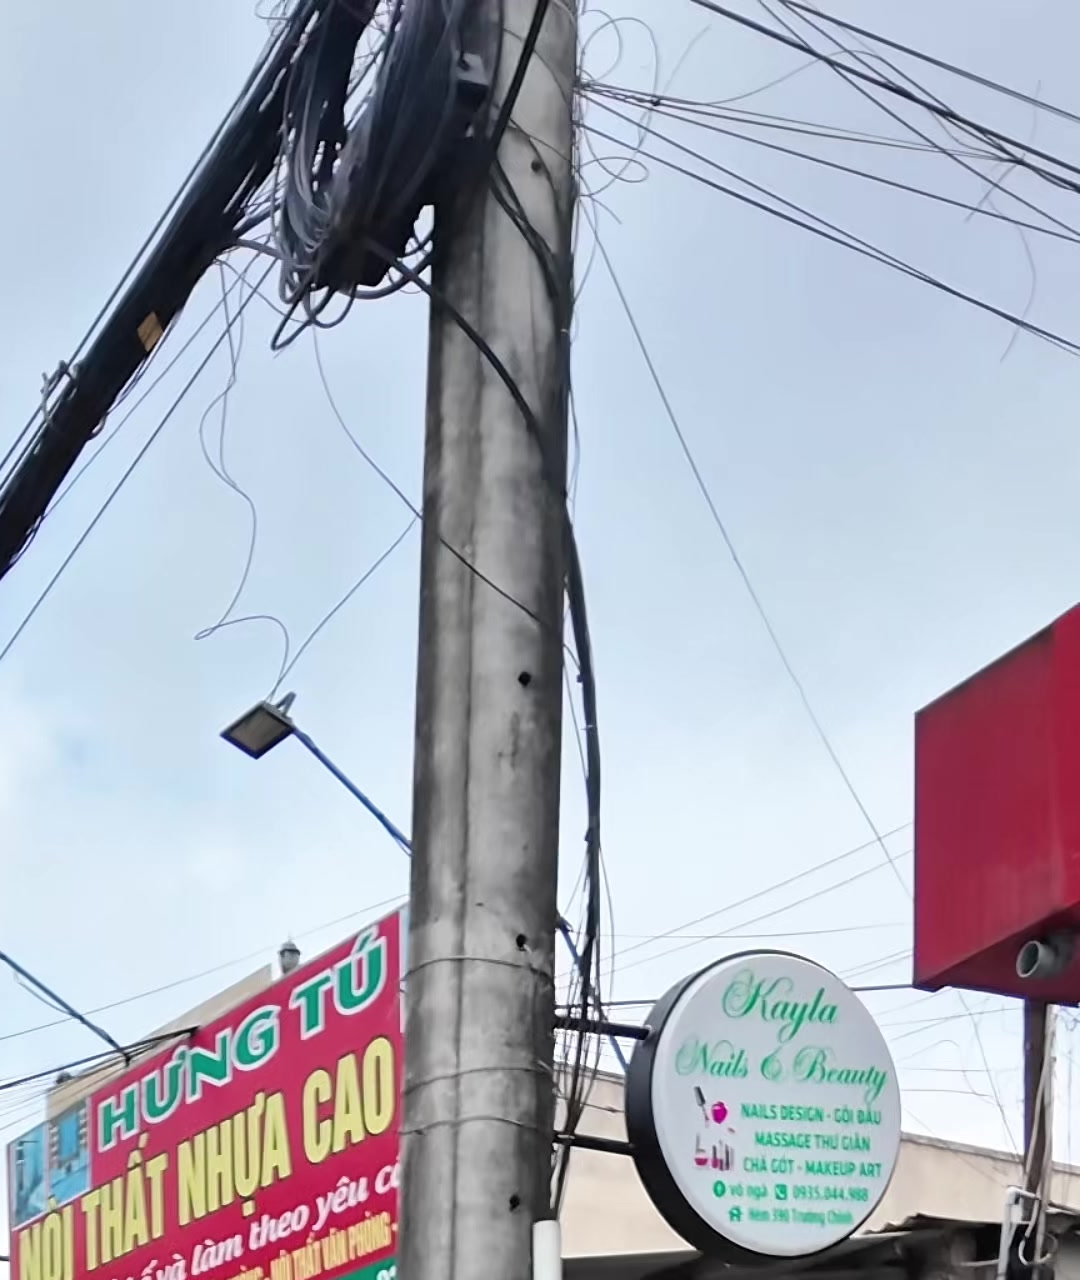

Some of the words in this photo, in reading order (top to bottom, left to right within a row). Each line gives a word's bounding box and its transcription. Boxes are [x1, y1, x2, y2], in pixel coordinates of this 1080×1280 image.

[97, 1004, 281, 1152] HƯNG
[289, 925, 388, 1041] TÚ
[722, 968, 840, 1043] Kayla
[675, 1035, 749, 1079] Nails
[793, 1045, 887, 1102] Beauty
[741, 1103, 777, 1120] NAILS
[780, 1105, 824, 1122] DESIGN
[755, 1131, 811, 1149] MASSAGE
[82, 1133, 168, 1271] THẤT
[177, 1091, 291, 1227] NHỰA
[303, 1036, 395, 1164] CAO
[805, 1160, 856, 1176] MAKEUP
[859, 1163, 882, 1178] ART
[191, 1235, 244, 1276] làm
[249, 1205, 309, 1250] theo
[312, 1176, 369, 1231] yêu
